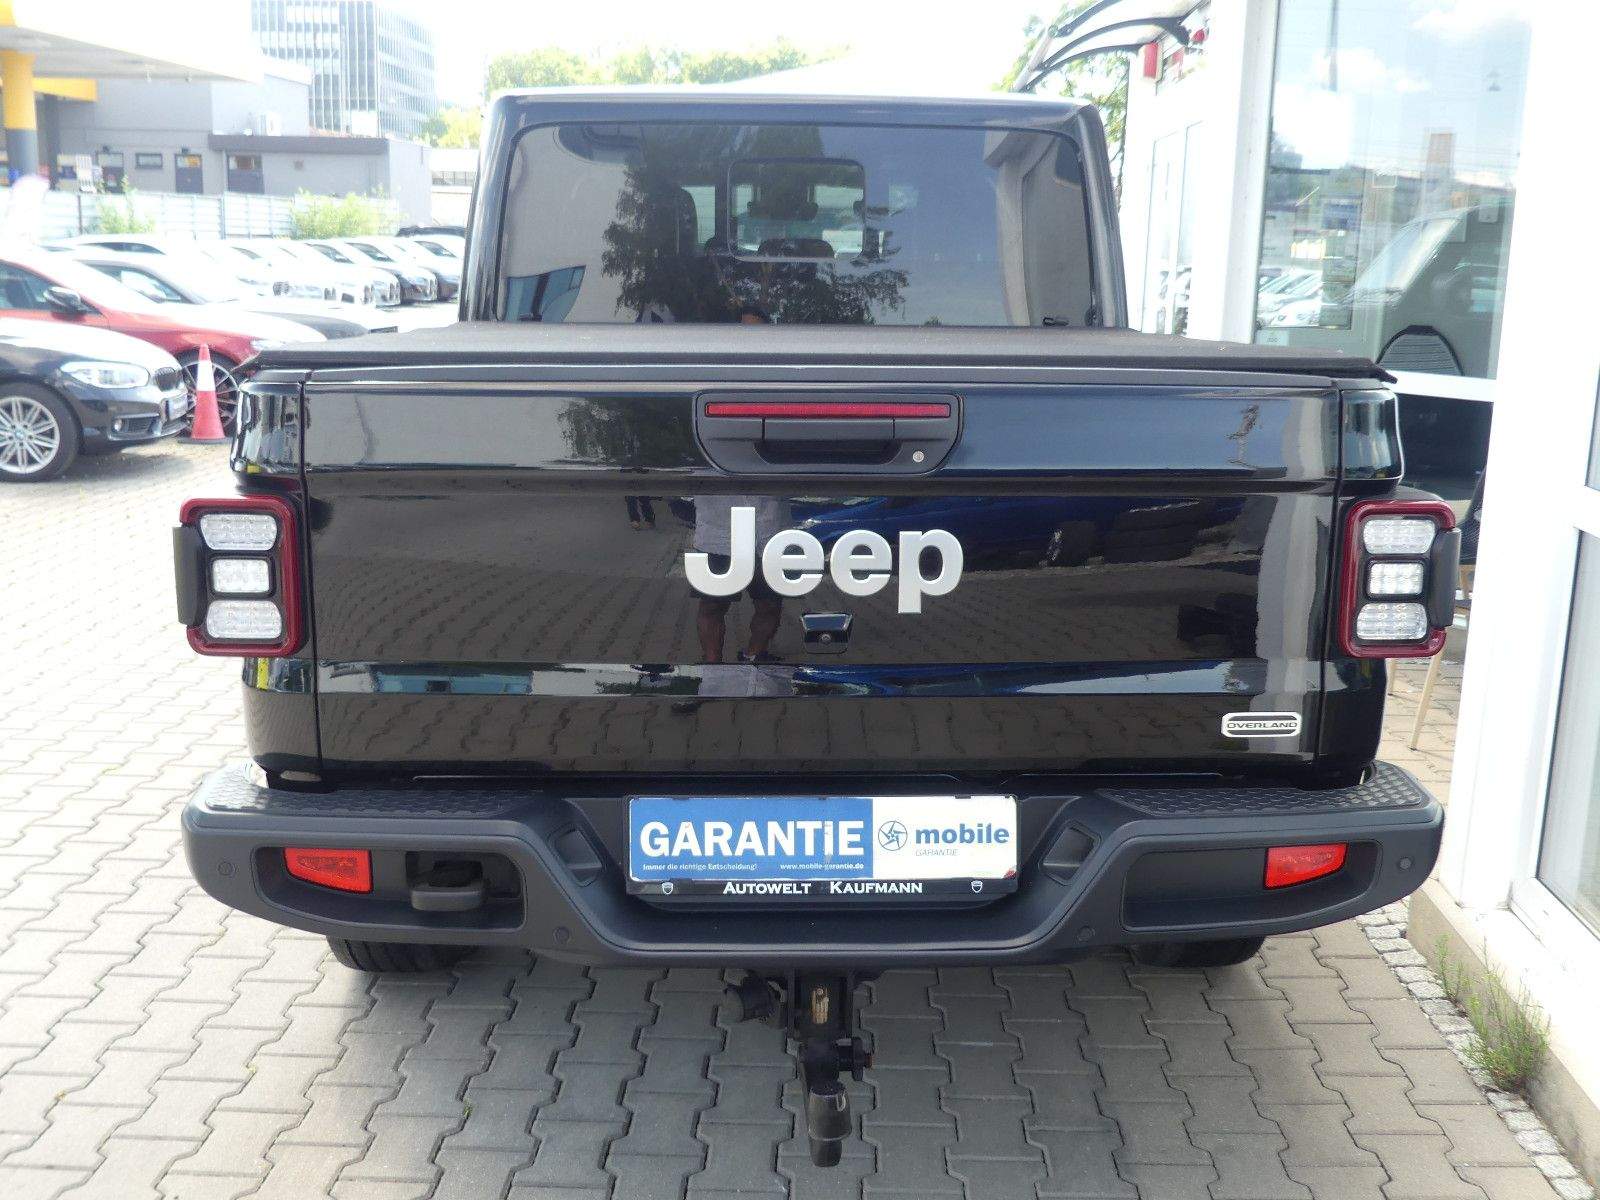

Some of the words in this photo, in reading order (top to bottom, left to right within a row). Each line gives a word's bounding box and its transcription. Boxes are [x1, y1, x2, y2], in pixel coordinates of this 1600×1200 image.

[684, 506, 964, 614] Jeep
[640, 821, 864, 857] GARANTIE
[915, 822, 1009, 844] mobile
[723, 881, 812, 894] AUTOWELT
[830, 881, 922, 894] KAUFMANN
